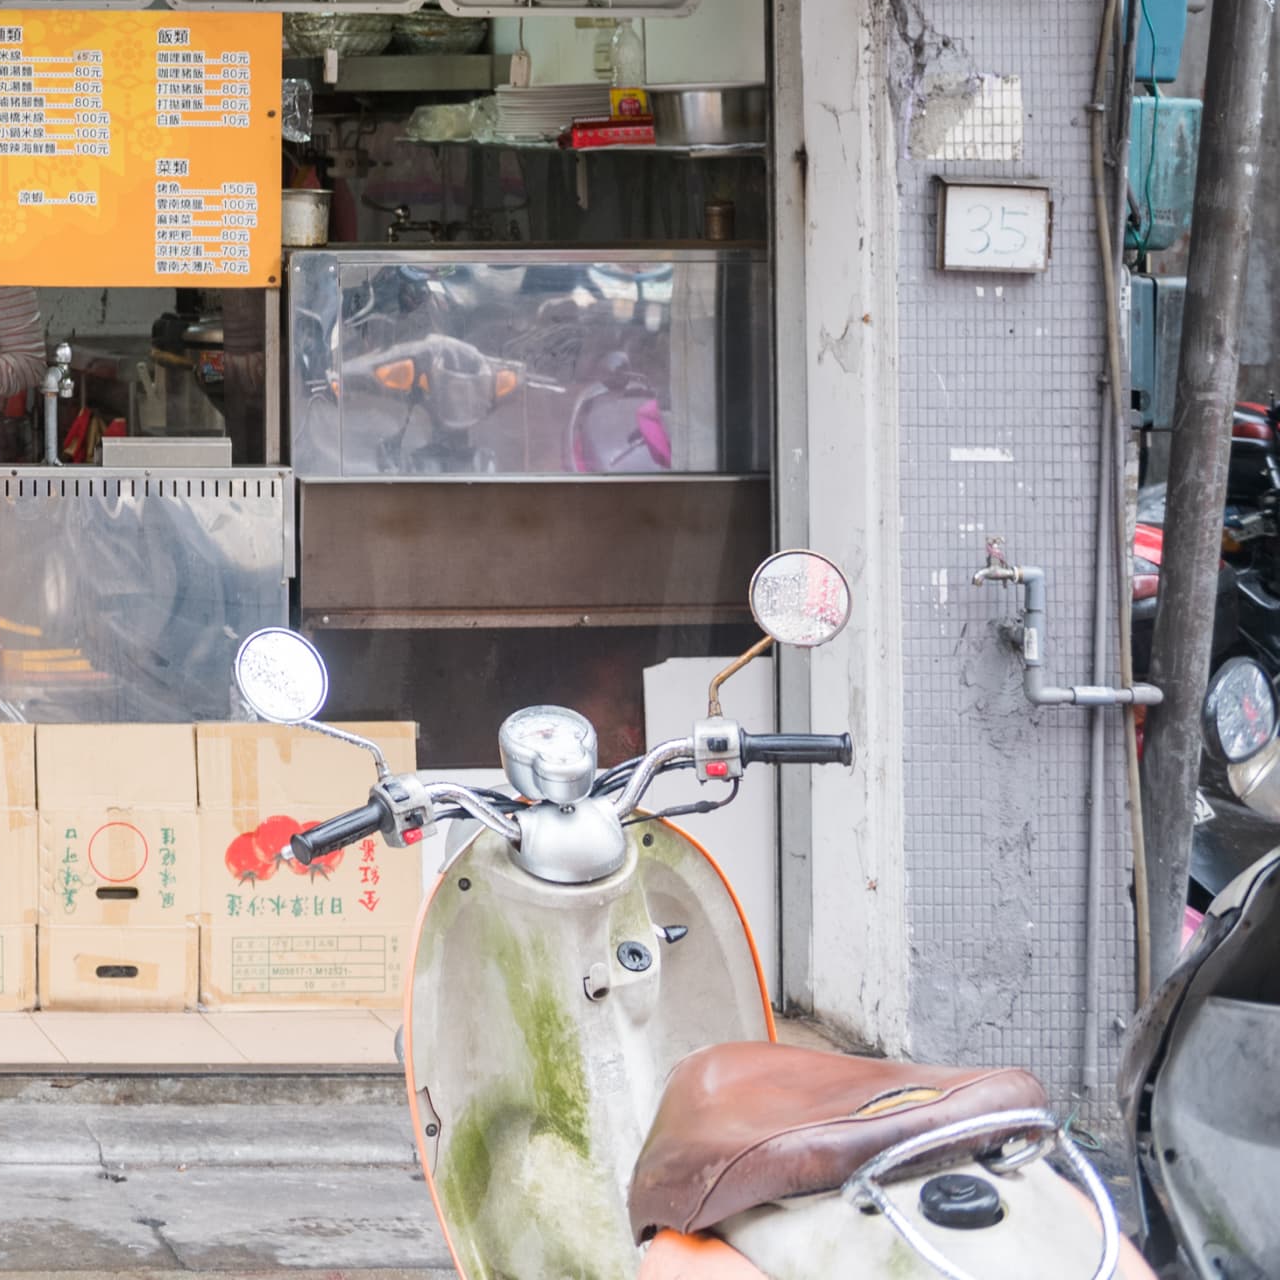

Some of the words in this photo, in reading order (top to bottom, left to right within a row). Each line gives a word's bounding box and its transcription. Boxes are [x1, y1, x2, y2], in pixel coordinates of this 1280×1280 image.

[158, 29, 189, 44] 飯類
[222, 53, 249, 64] 80元
[74, 67, 102, 77] 80元
[222, 69, 249, 80] 80元
[74, 82, 102, 93] 80元
[222, 84, 249, 95] 80元
[74, 97, 102, 108] 80元
[222, 100, 249, 111] 80元
[74, 113, 110, 124] 100元
[157, 114, 180, 125] 白飯
[222, 115, 249, 126] 10元
[74, 128, 110, 139] 100元
[74, 144, 110, 155] 100元
[157, 160, 188, 175] 菜類
[157, 183, 179, 194] 烤魚
[222, 184, 256, 195] 150元
[69, 193, 96, 204] 60元
[222, 200, 257, 211] 100元
[157, 215, 191, 225] 麻辣菜
[222, 216, 257, 226] 100元
[966, 204, 1029, 255] 35
[222, 231, 249, 242] 80元
[222, 247, 249, 258] 70元
[222, 262, 249, 273] 70元
[159, 827, 178, 909] 風味絕佳
[358, 832, 381, 913] 全紅蕃
